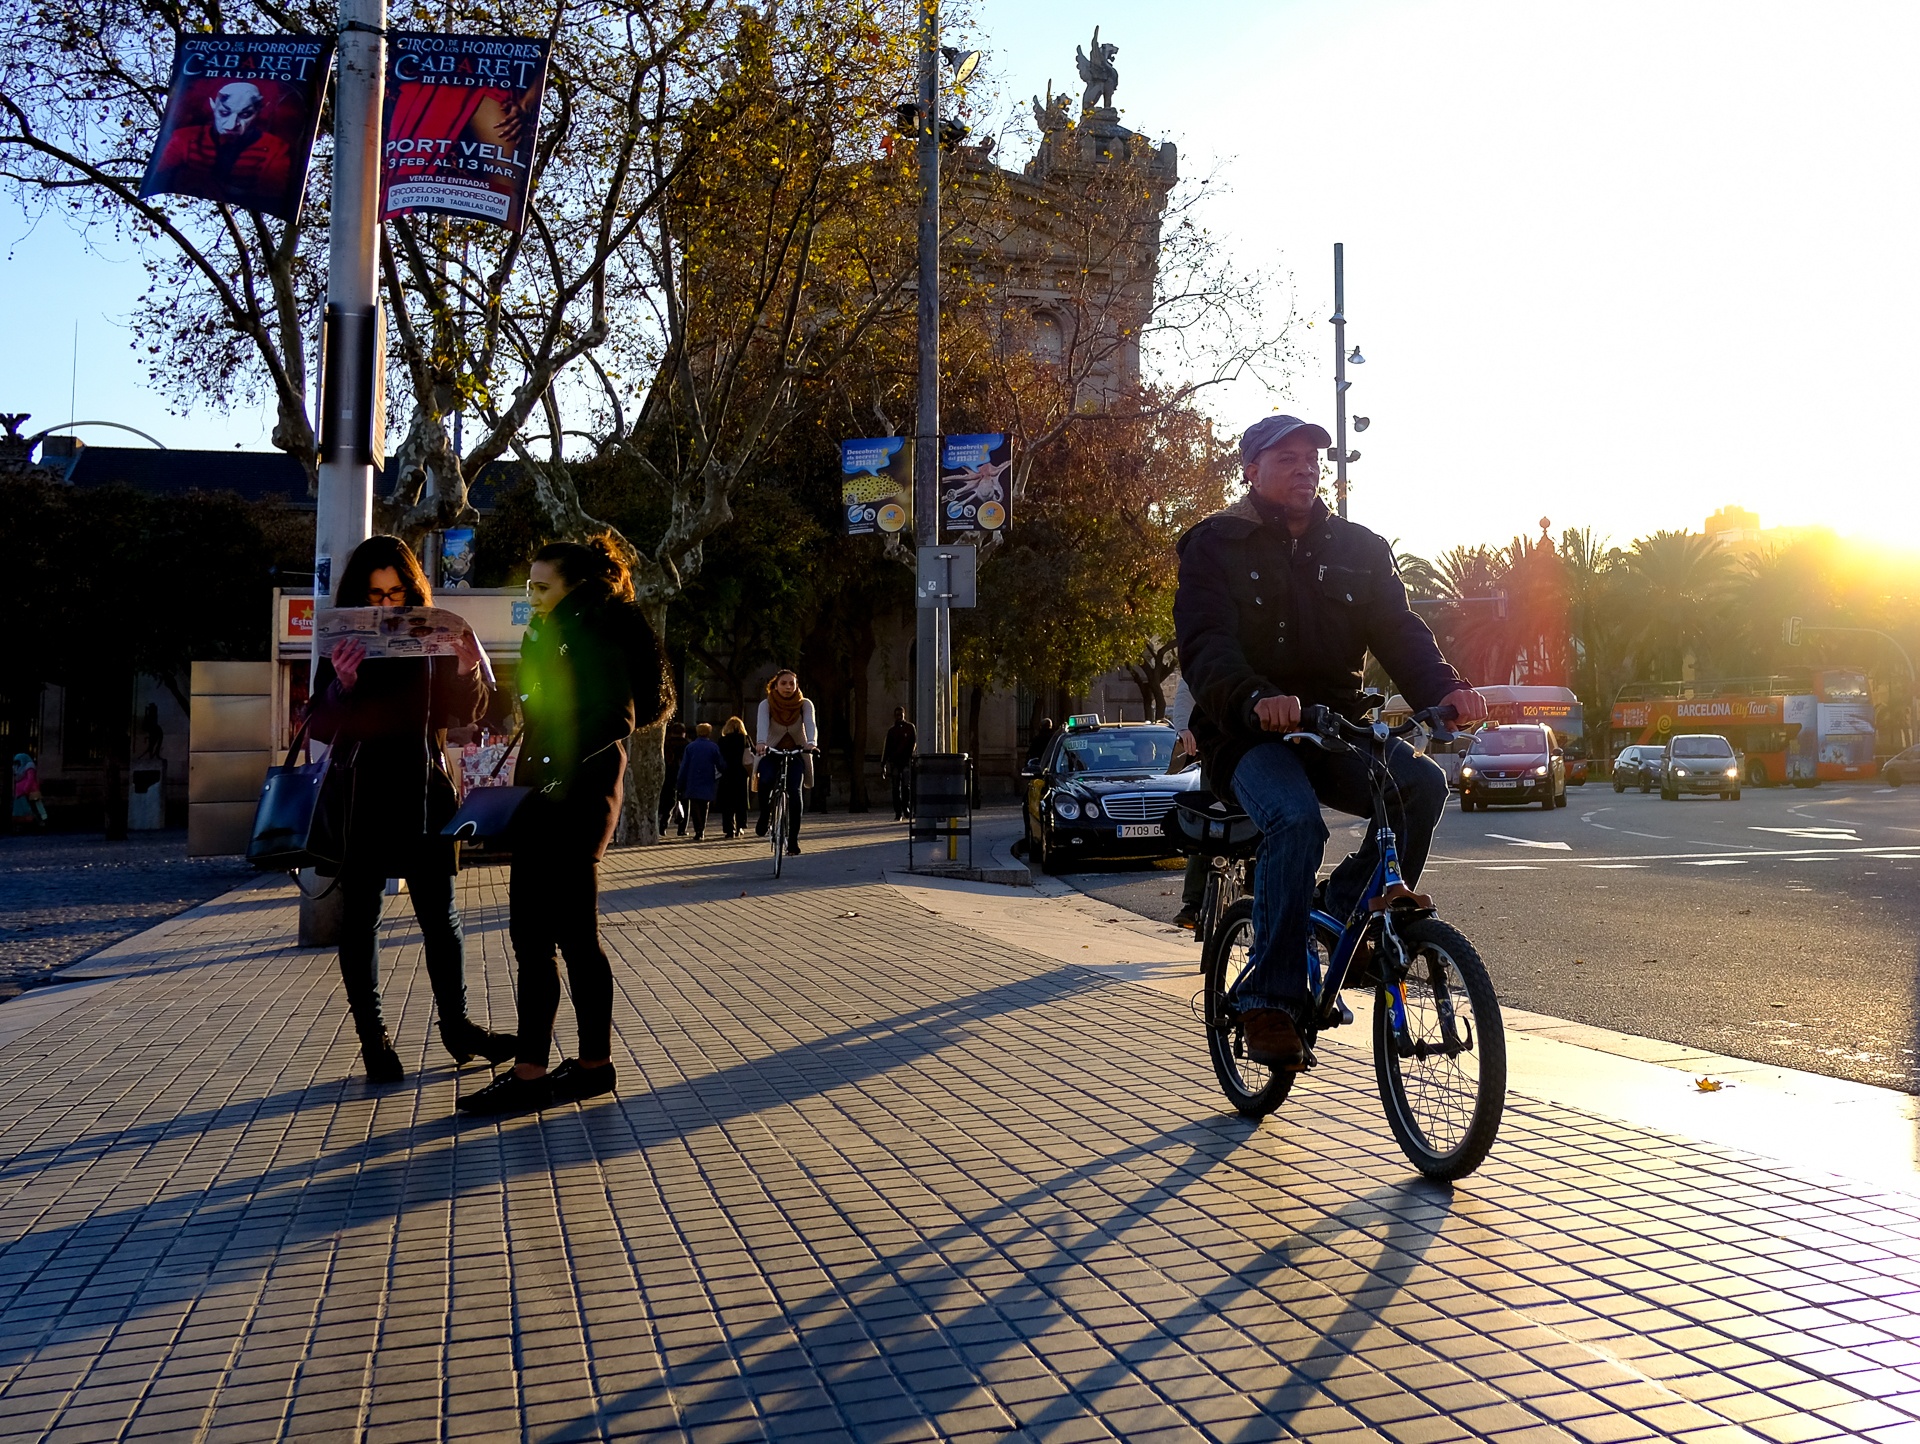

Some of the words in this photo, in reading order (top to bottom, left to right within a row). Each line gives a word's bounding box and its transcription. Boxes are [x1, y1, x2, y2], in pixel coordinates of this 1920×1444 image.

[185, 40, 231, 53] CIRCO
[247, 42, 321, 55] HORRORES
[397, 37, 444, 54] CIRCO
[461, 41, 541, 58] HORRORES
[183, 53, 316, 81] CABARET
[395, 54, 536, 89] CABARET
[205, 69, 292, 81] MALDITO
[422, 75, 511, 88] MALDITO
[386, 138, 452, 157] PORT
[460, 141, 526, 168] VELL
[399, 158, 429, 167] FEB.
[433, 158, 451, 167] AL
[458, 158, 479, 170] 13
[483, 164, 516, 179] MAR.
[409, 175, 434, 183] VENTA
[447, 177, 490, 189] ENTRADAS
[390, 186, 506, 206] CIRCODELOSHORRORES.COM
[401, 196, 414, 204] 637
[431, 196, 445, 204] 138
[450, 199, 484, 210] TAQUILLAS
[484, 205, 503, 215] CIRCO
[1523, 706, 1538, 716] D20
[1677, 702, 1731, 717] BARCELONA
[1075, 717, 1088, 725] TAXI
[1125, 825, 1149, 836] 7109
